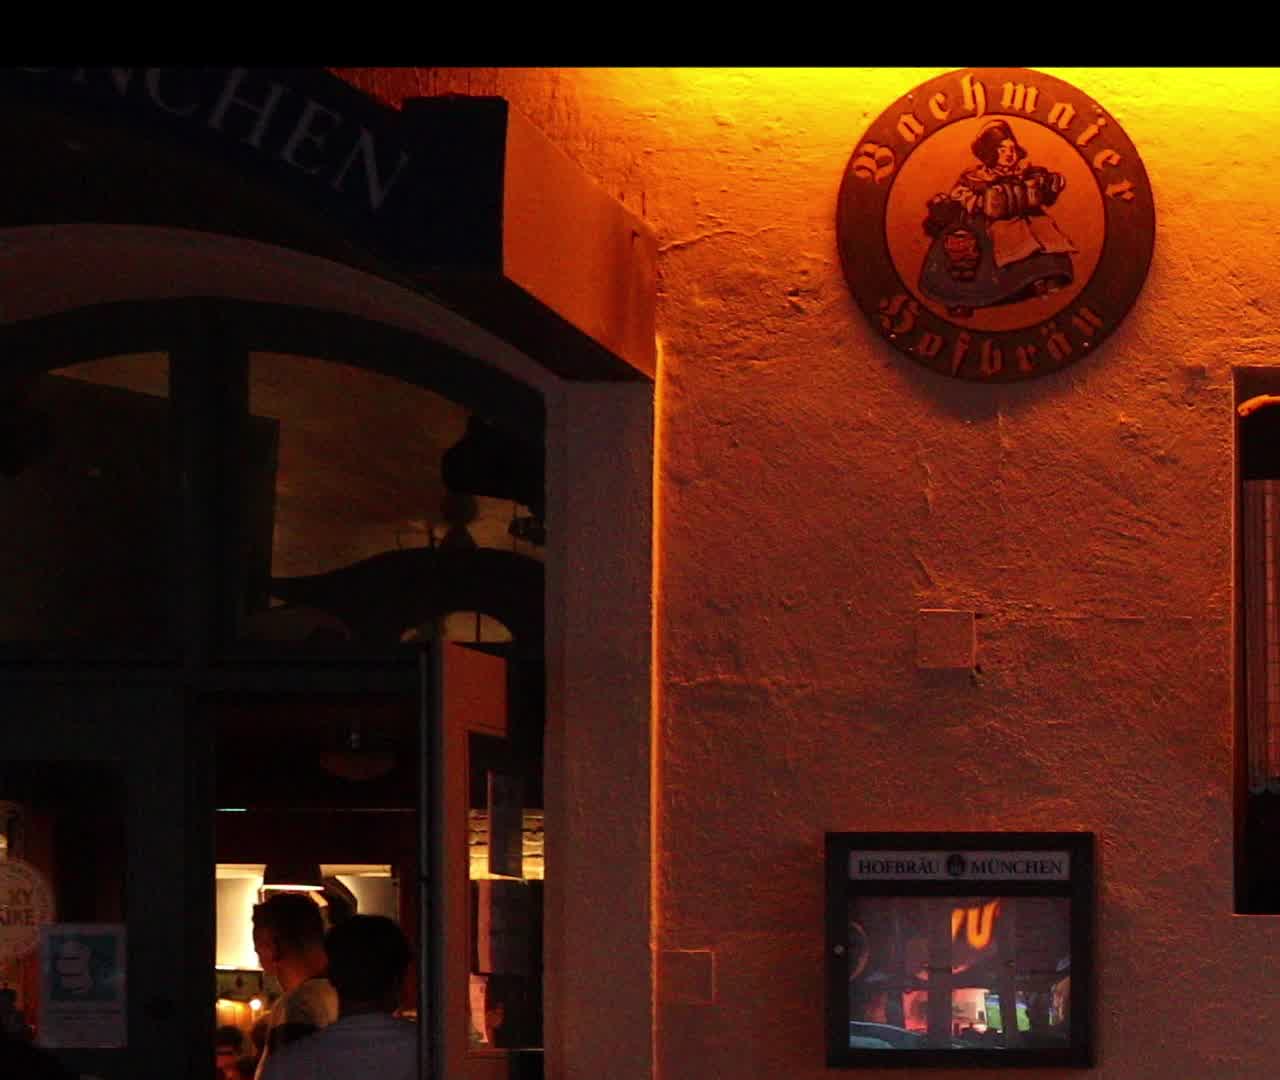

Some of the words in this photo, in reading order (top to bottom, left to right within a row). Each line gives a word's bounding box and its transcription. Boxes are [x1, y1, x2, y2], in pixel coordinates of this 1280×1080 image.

[852, 72, 1138, 203] Bachmaier
[879, 293, 1104, 377] Hofbräu
[858, 855, 940, 876] HOFBRÄU
[970, 855, 1064, 876] MÜNCHEN
